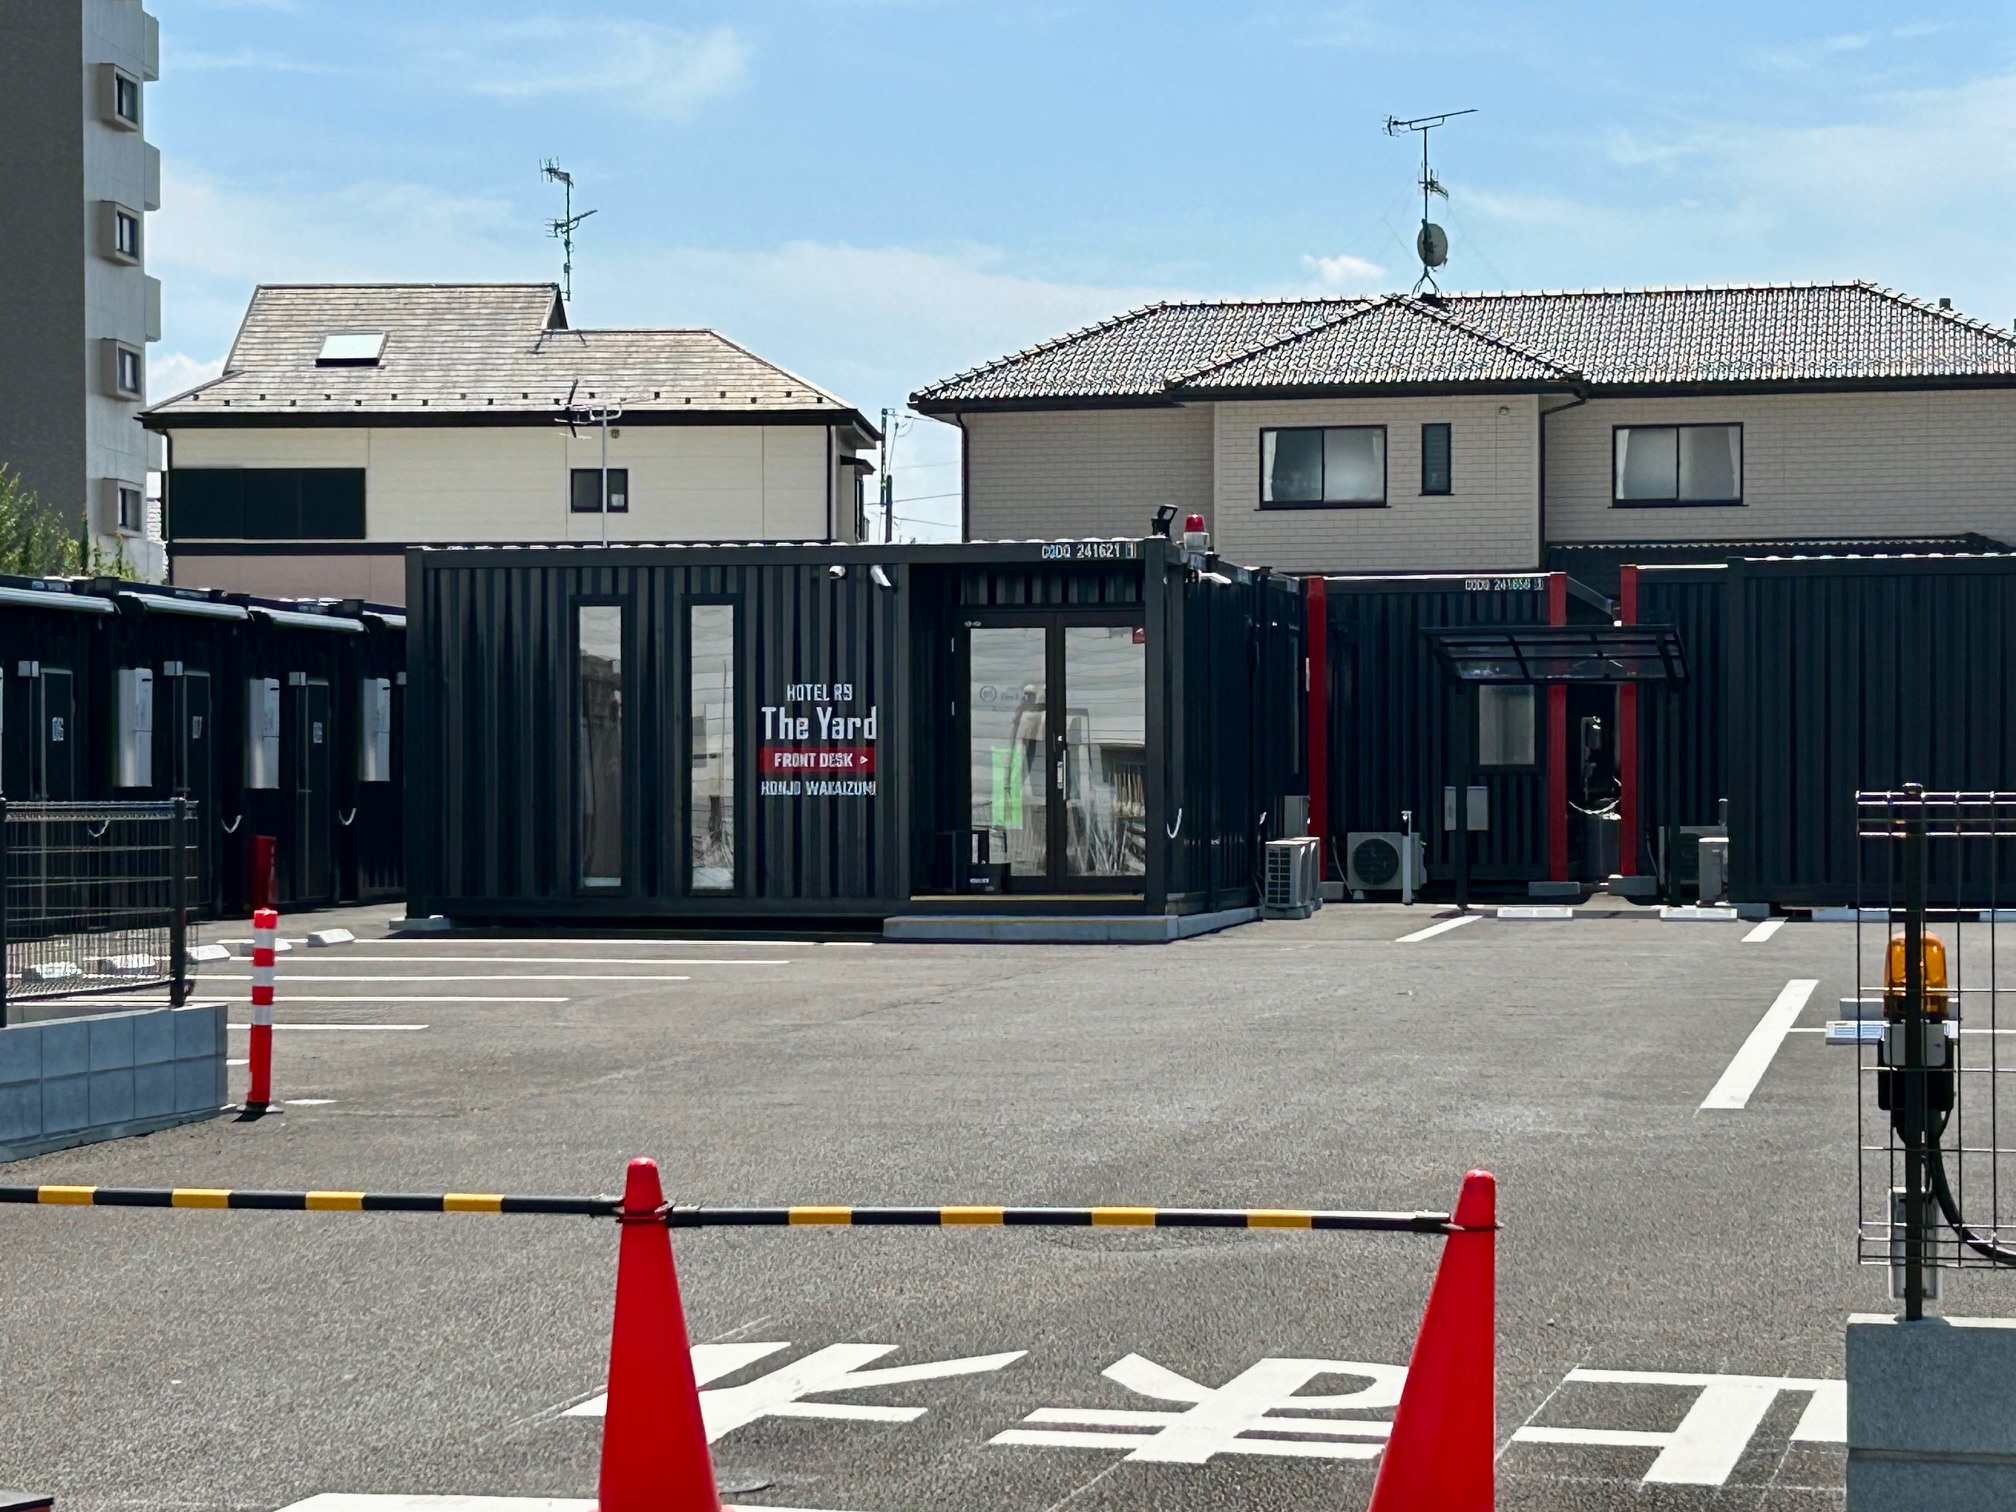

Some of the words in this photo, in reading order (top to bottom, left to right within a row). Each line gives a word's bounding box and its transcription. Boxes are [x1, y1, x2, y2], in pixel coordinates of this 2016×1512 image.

[787, 683, 830, 702] HOTEL
[833, 683, 853, 701] R9
[761, 706, 809, 740] The
[816, 705, 877, 740] Yard
[774, 752, 817, 768] FRONT
[819, 752, 853, 768] DESK
[761, 780, 801, 796] HONJO
[805, 780, 877, 796] WAKAIZUMI
